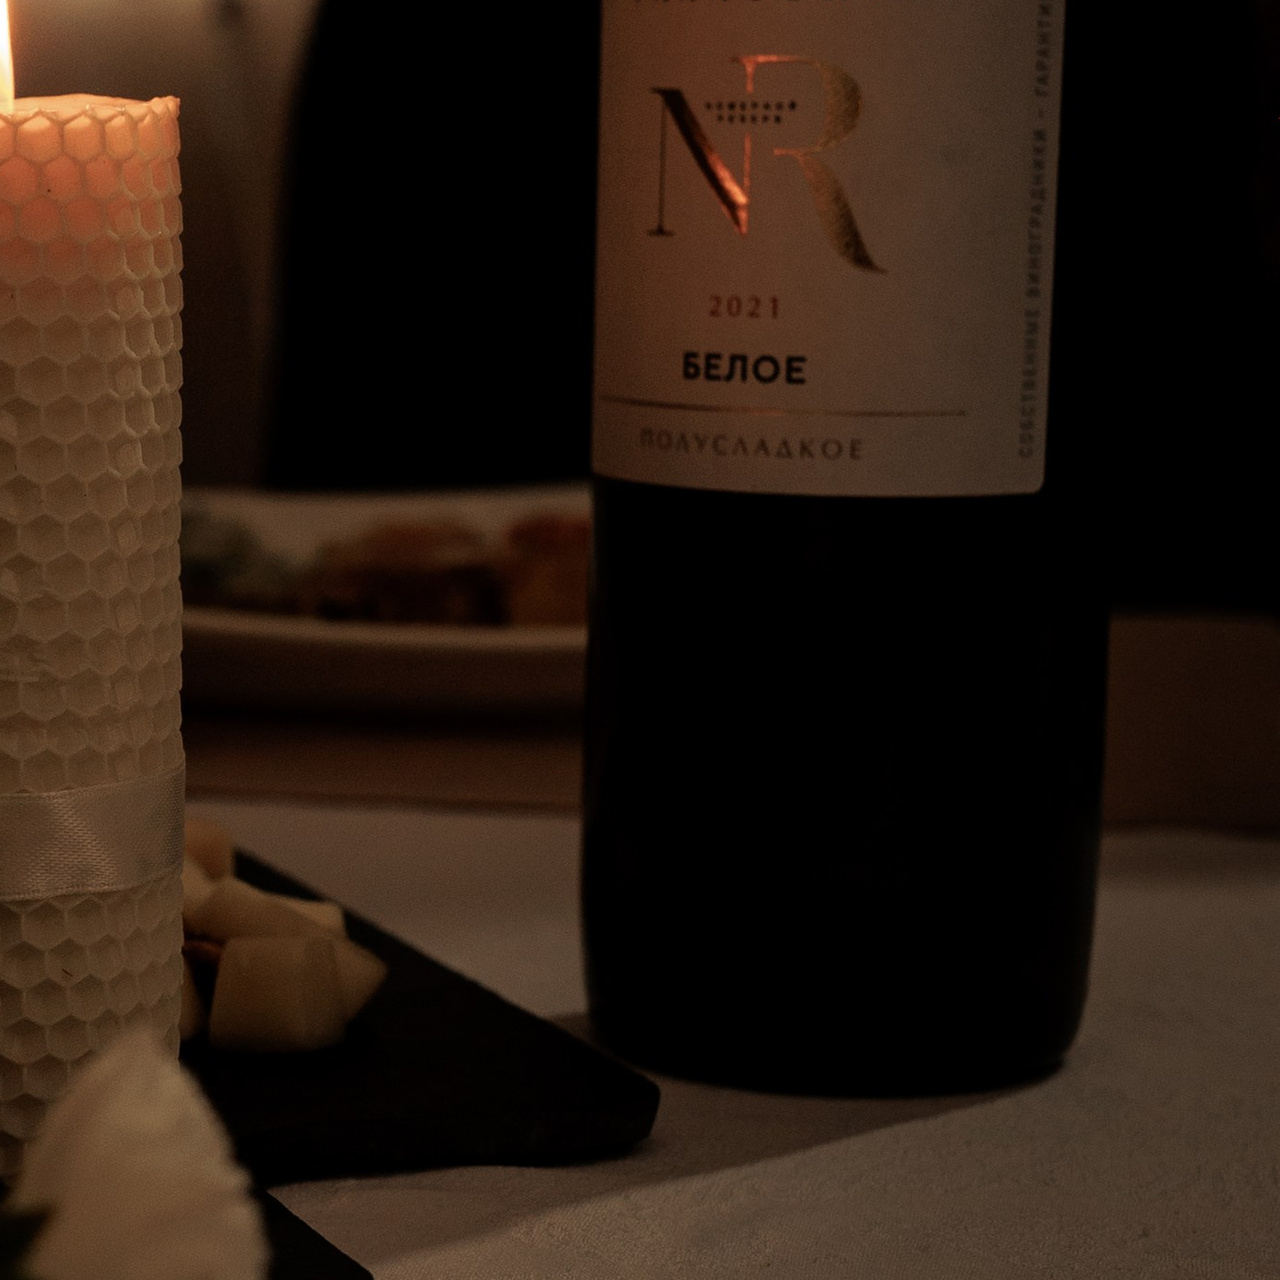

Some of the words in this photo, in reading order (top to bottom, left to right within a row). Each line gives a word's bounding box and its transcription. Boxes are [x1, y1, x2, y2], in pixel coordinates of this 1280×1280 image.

[709, 294, 779, 319] 2021
[682, 351, 807, 384] БЕЛОЕ
[639, 427, 864, 460] ПОЛУСЛАДКОЕ
